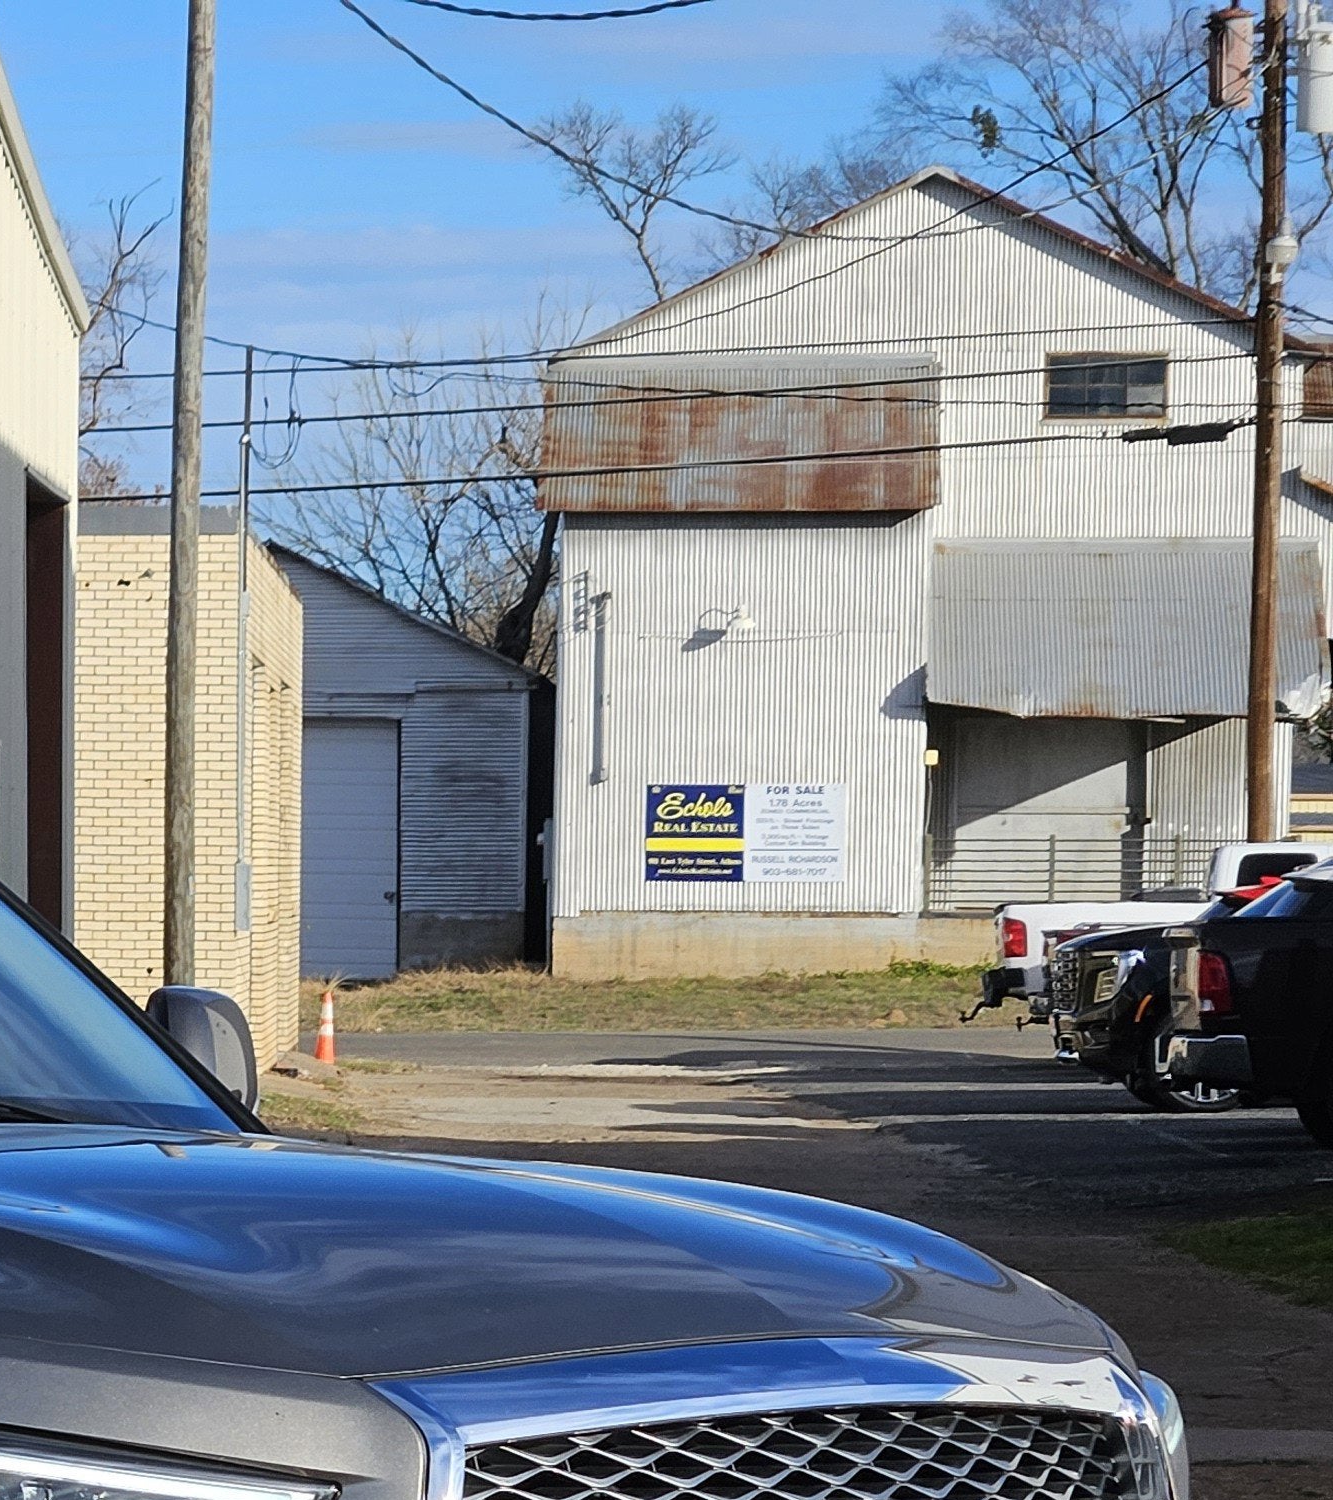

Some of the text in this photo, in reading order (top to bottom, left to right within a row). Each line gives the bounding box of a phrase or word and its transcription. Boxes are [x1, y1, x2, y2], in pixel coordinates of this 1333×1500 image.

[766, 785, 825, 795] FOR SALE
[656, 792, 735, 820] Echols
[792, 798, 823, 807] Acres
[653, 822, 738, 833] REAL ESTATE
